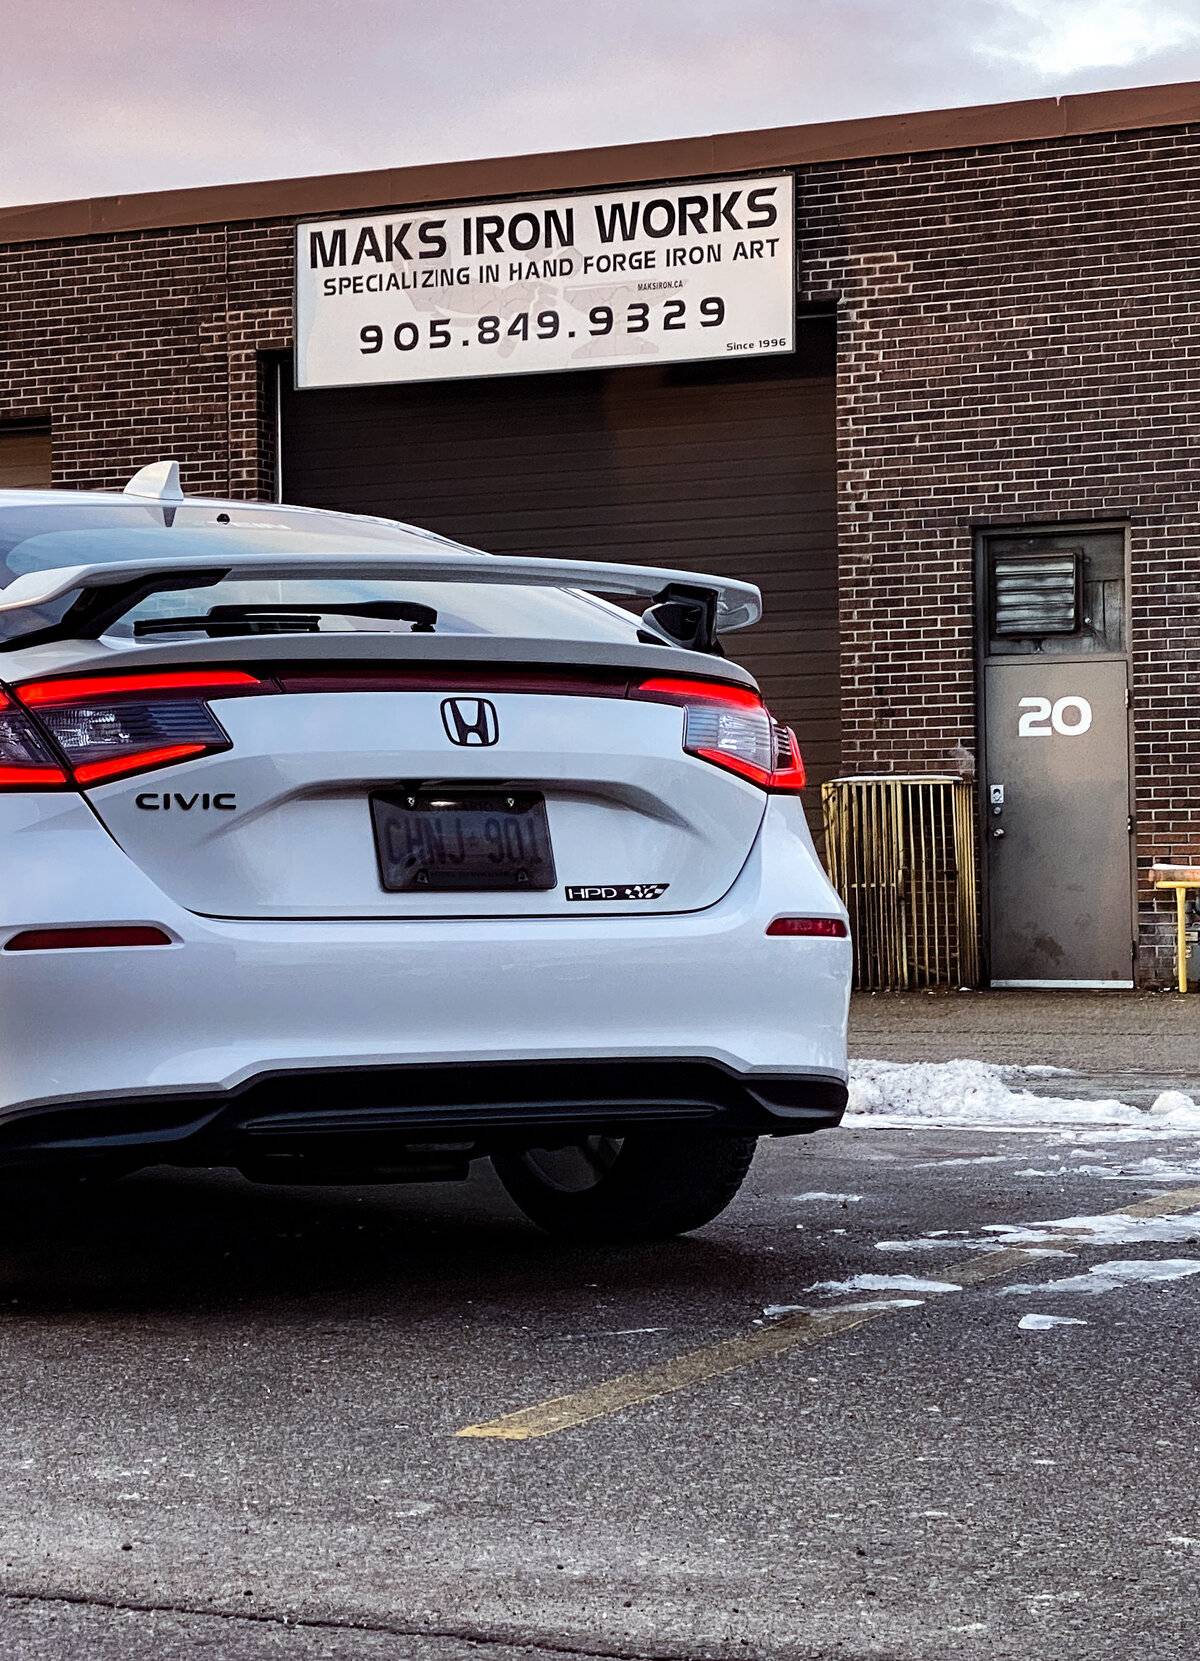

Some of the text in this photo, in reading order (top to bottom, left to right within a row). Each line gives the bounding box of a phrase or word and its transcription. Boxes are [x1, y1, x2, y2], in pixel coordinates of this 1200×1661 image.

[310, 187, 777, 269] MAKS IRON WORKS
[323, 238, 779, 296] SPECIALIZING IN HAND FORGE IRON ART
[637, 280, 683, 291] MAKSIRON.CA
[360, 296, 725, 355] 905.849.9329
[726, 338, 786, 351] Since 1996
[1018, 696, 1093, 736] 20
[135, 793, 237, 810] CIVIC
[568, 887, 618, 899] HPD
